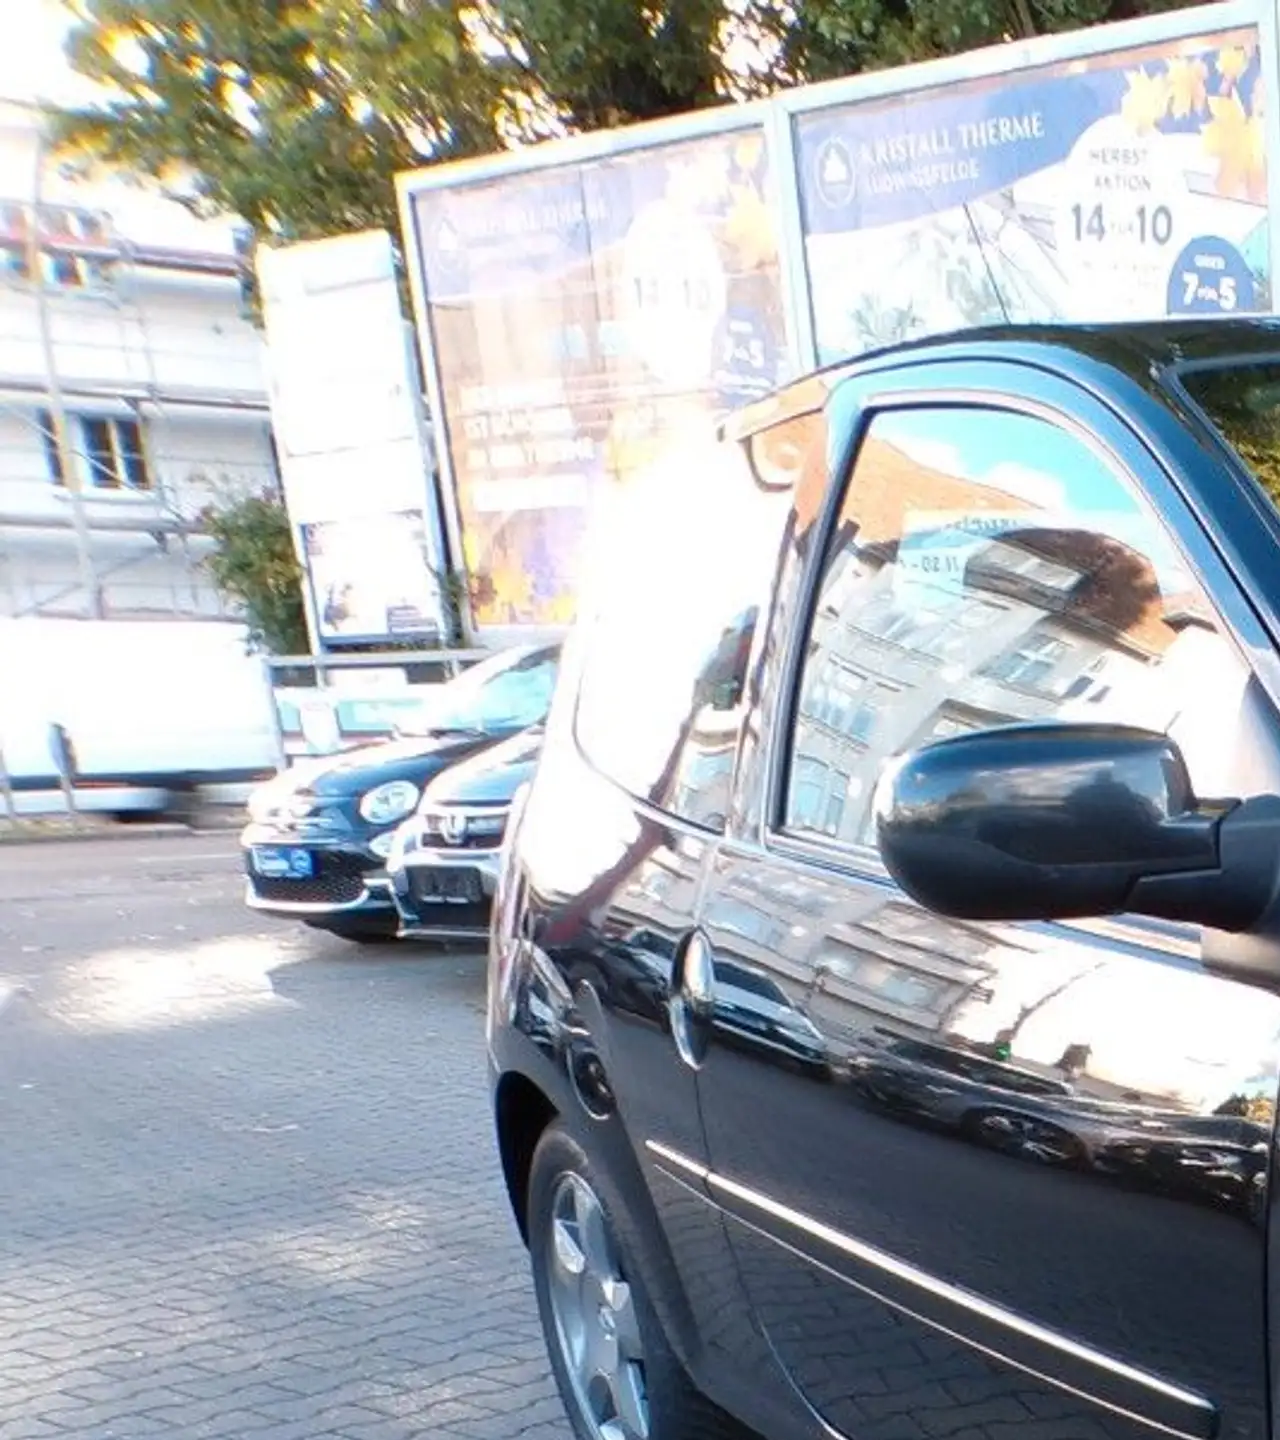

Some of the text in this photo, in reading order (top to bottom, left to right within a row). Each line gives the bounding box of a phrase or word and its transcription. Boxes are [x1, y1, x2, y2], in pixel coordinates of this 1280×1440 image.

[958, 112, 1045, 149] THERME
[1071, 202, 1105, 242] 14
[1136, 204, 1173, 246] 10
[1182, 271, 1199, 306] 7
[1219, 275, 1237, 311] 5
